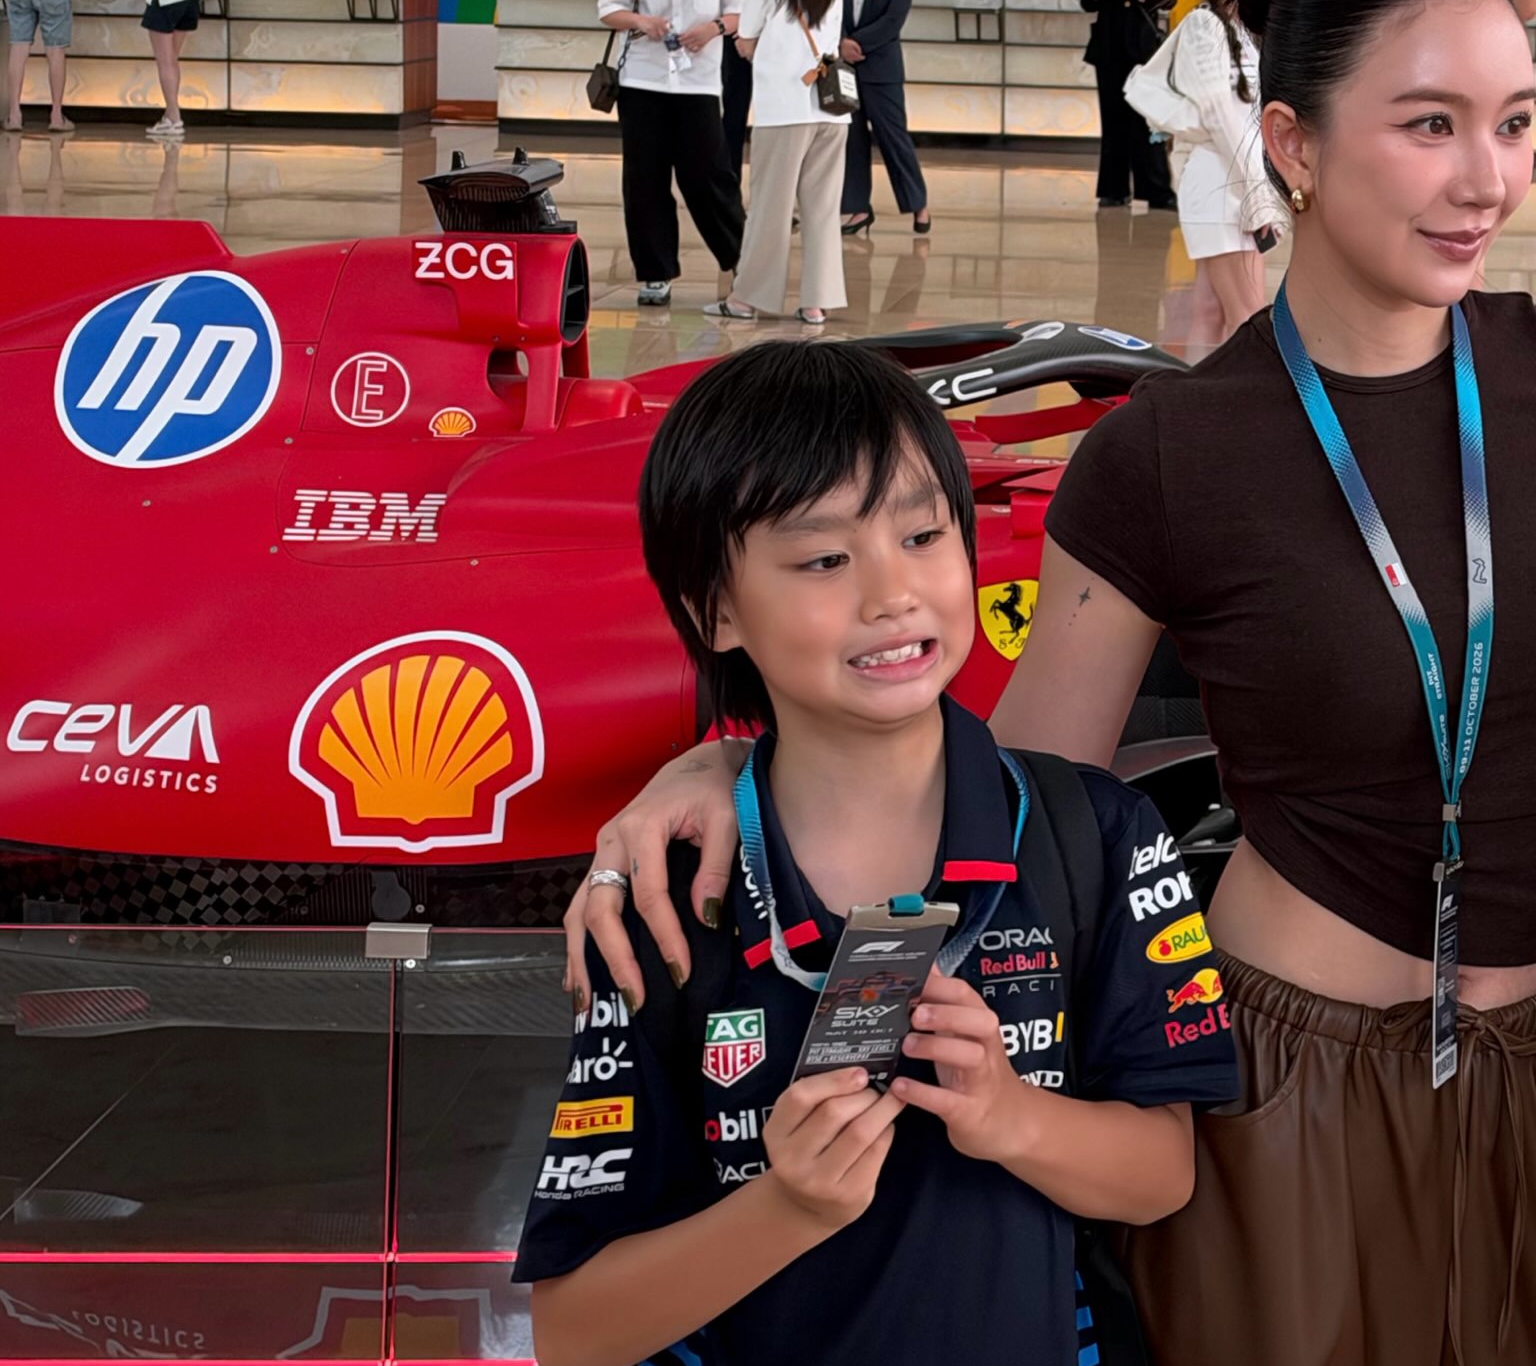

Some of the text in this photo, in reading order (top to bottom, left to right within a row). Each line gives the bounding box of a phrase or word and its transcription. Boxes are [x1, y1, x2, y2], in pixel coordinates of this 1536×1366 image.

[77, 275, 258, 461] hp
[283, 489, 447, 543] IBM
[1472, 642, 1483, 674] 2026
[1465, 676, 1480, 736] OCTOBER
[80, 763, 218, 794] LOGISTICS
[1128, 832, 1176, 881] telc
[979, 926, 1054, 951] ORA
[1171, 925, 1207, 951] RAU
[980, 951, 1046, 976] Red Bull
[982, 980, 1055, 999] RACI
[831, 1018, 880, 1028] SUITE
[834, 1004, 900, 1020] SKY
[1165, 1007, 1217, 1048] Red
[999, 1011, 1065, 1057] BYBI
[703, 1043, 760, 1081] EUER
[705, 1109, 758, 1142] obil
[537, 1148, 634, 1190] HRC
[534, 1183, 625, 1200] Honda RACING
